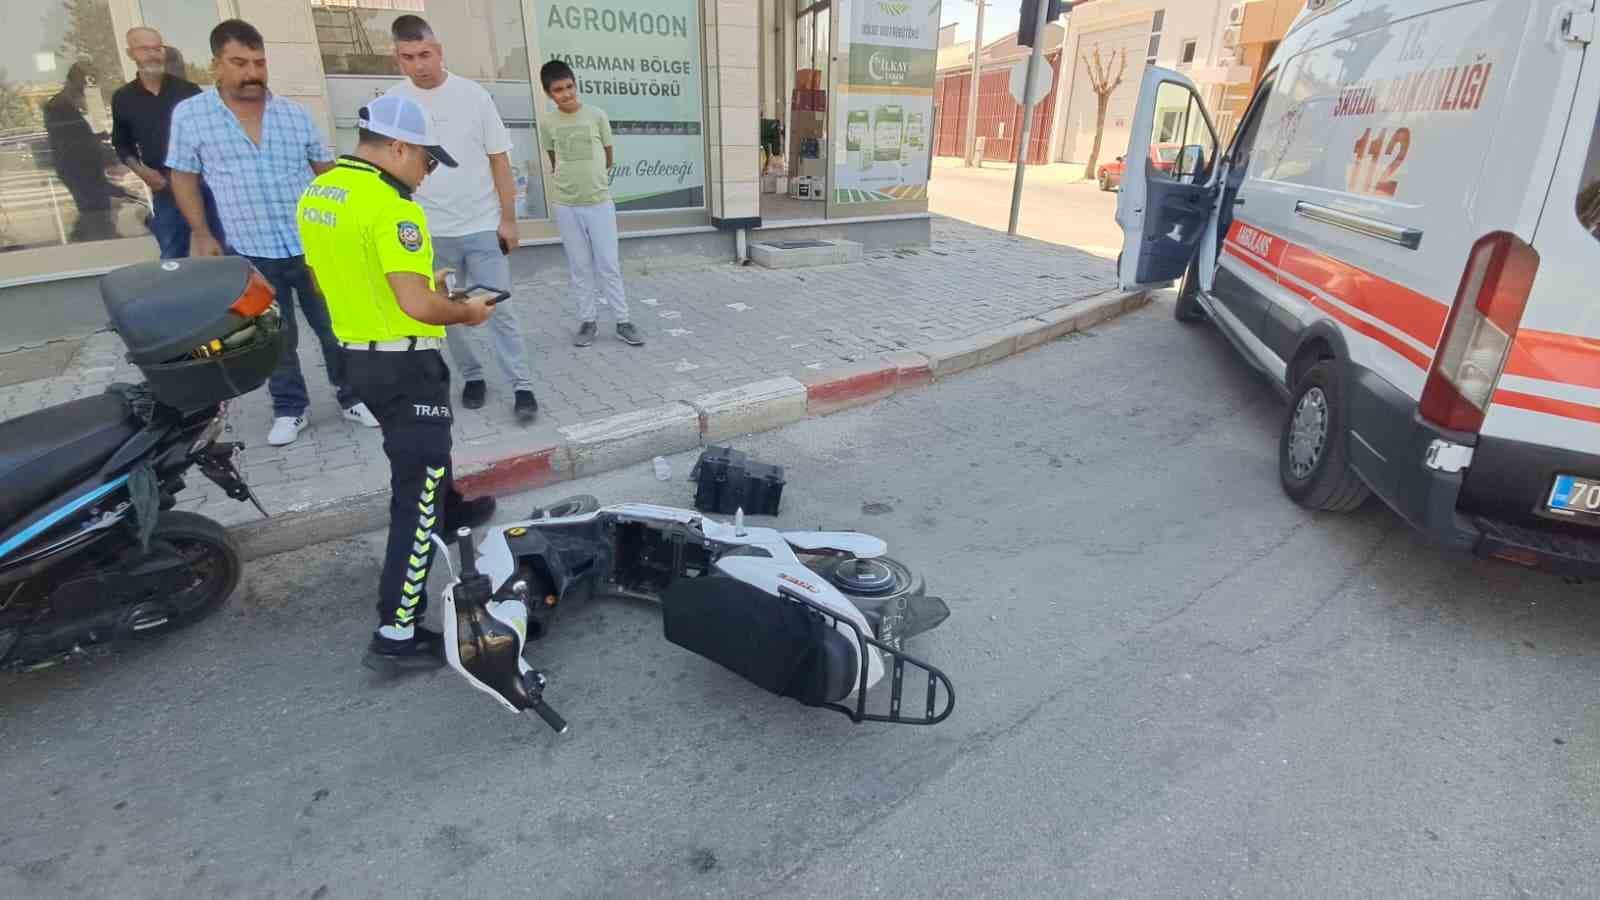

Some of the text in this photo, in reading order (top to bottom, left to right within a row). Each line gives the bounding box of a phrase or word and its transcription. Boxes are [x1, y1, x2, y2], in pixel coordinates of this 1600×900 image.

[547, 4, 688, 38] AGROMOON
[640, 56, 693, 75] BÖLGE
[578, 75, 681, 97] İSTRİBÜTÖRÜ
[635, 159, 694, 184] Geleceği
[1348, 127, 1411, 197] 112
[1569, 482, 1600, 509] 70
